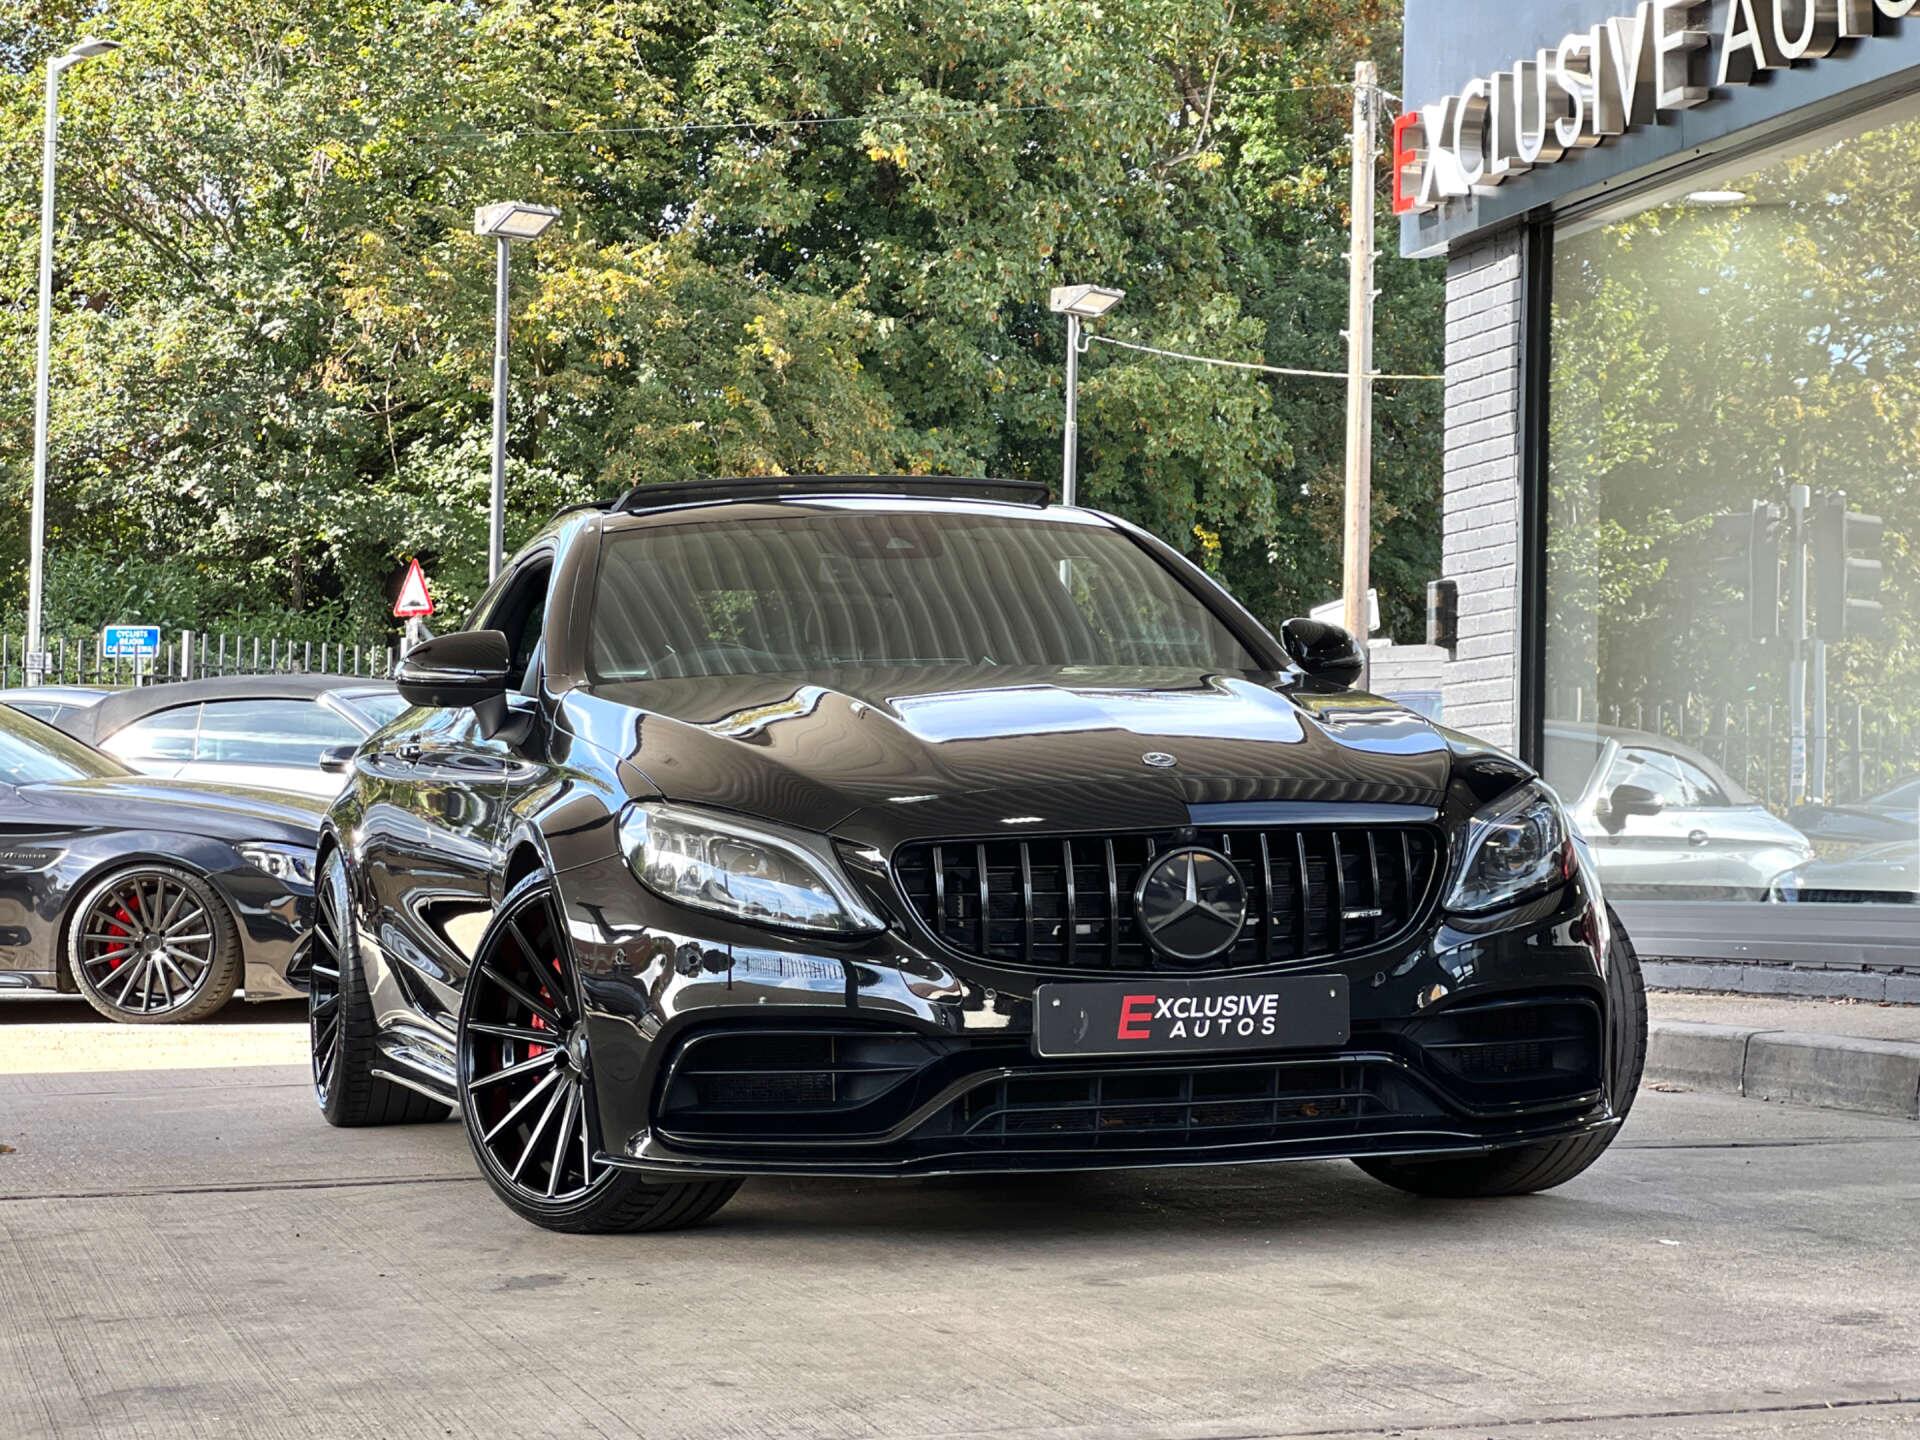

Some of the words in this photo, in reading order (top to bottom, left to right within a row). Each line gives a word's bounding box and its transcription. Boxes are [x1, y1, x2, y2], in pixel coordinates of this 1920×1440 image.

[1393, 0, 1706, 214] EXCLUSIVE
[1117, 994, 1279, 1039] EXCLUSIVE
[1169, 1016, 1276, 1039] AUTOS
